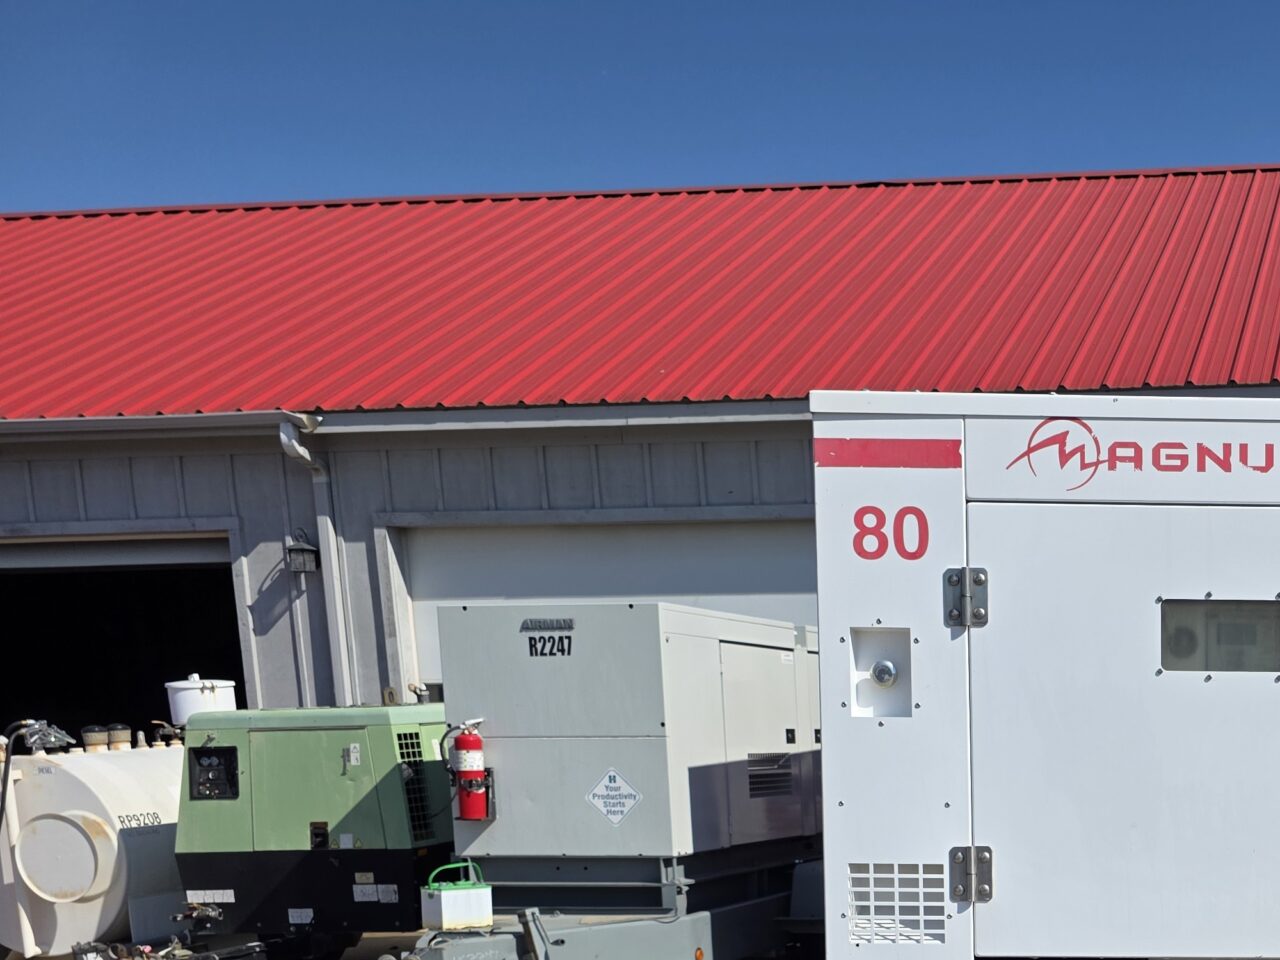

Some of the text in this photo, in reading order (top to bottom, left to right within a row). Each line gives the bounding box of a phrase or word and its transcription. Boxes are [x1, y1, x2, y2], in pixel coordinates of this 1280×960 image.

[853, 505, 929, 560] 80
[527, 635, 572, 657] R2247
[604, 784, 621, 793] Your
[592, 792, 637, 801] Productivity
[602, 800, 626, 808] Starts
[118, 811, 162, 830] RP9208
